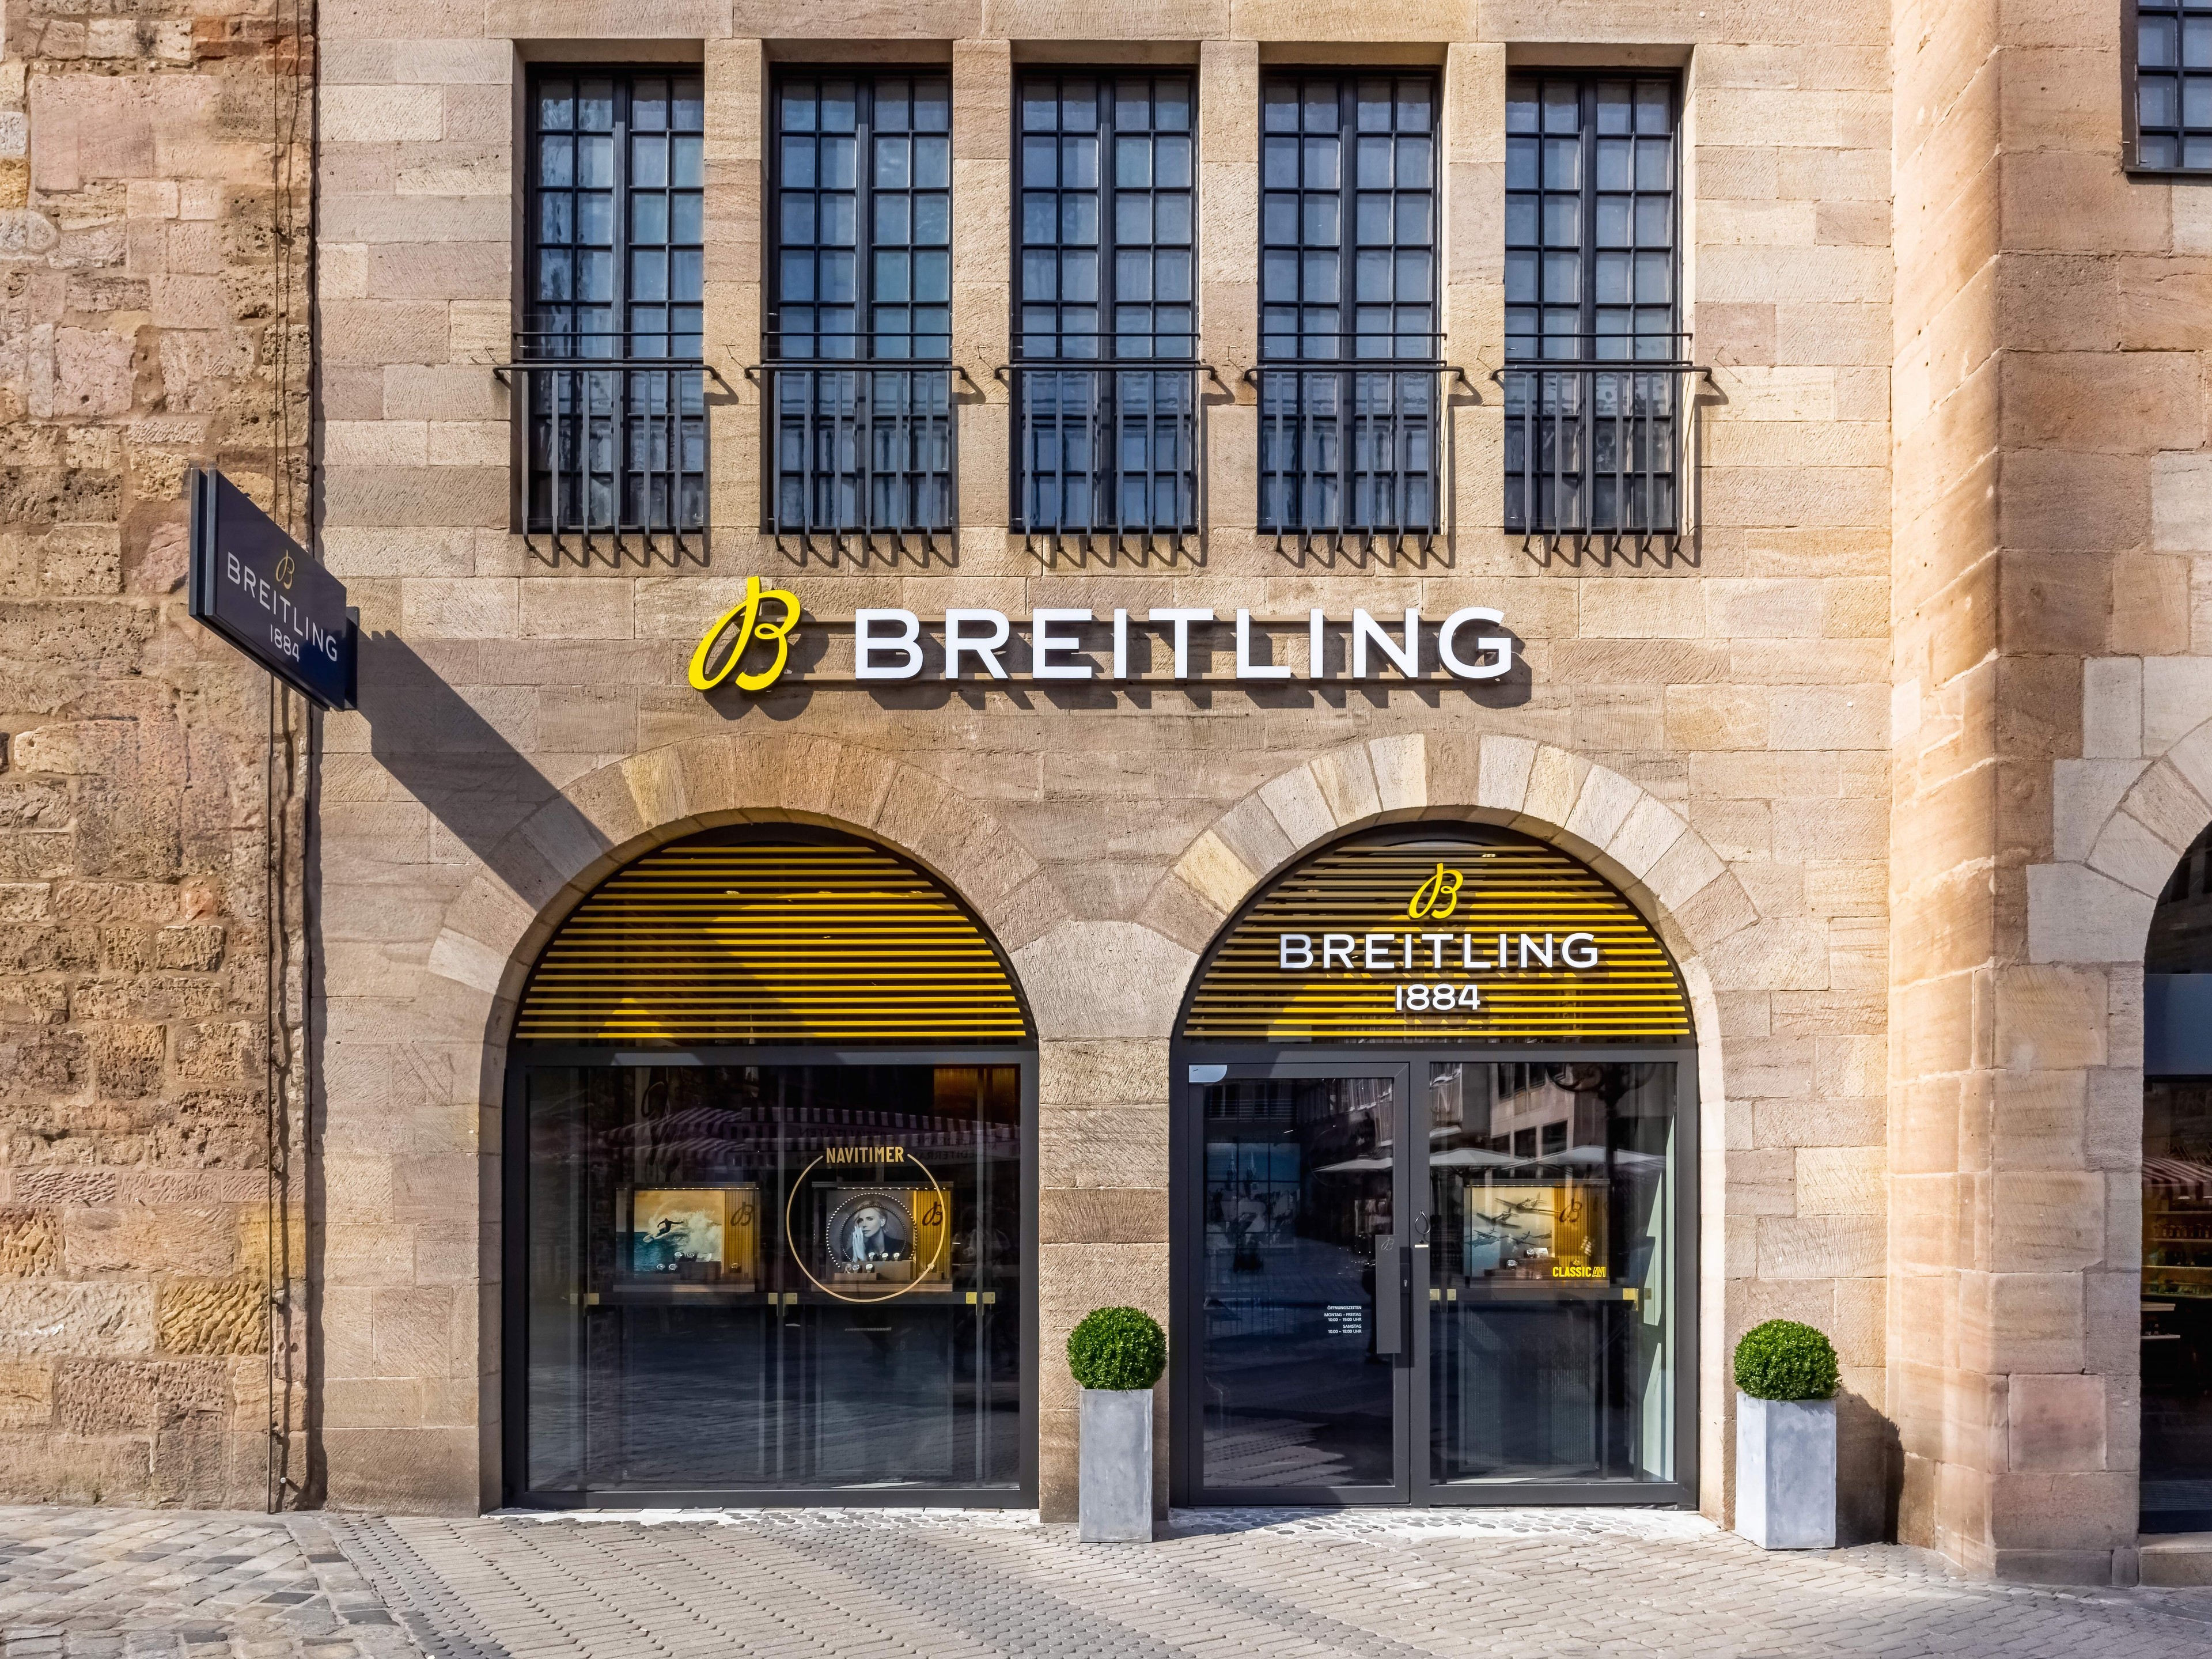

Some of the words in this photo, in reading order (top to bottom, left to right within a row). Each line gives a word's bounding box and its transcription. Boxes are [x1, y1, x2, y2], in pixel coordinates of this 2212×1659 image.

[228, 551, 338, 662] BREITLING
[270, 624, 300, 662] 1884
[855, 607, 1513, 680] BREITLING
[1280, 932, 1599, 970] BREITLING
[1395, 983, 1481, 1012] 1884
[826, 1146, 904, 1164] NAVITIMER
[1552, 1266, 1592, 1278] CLASSIC
